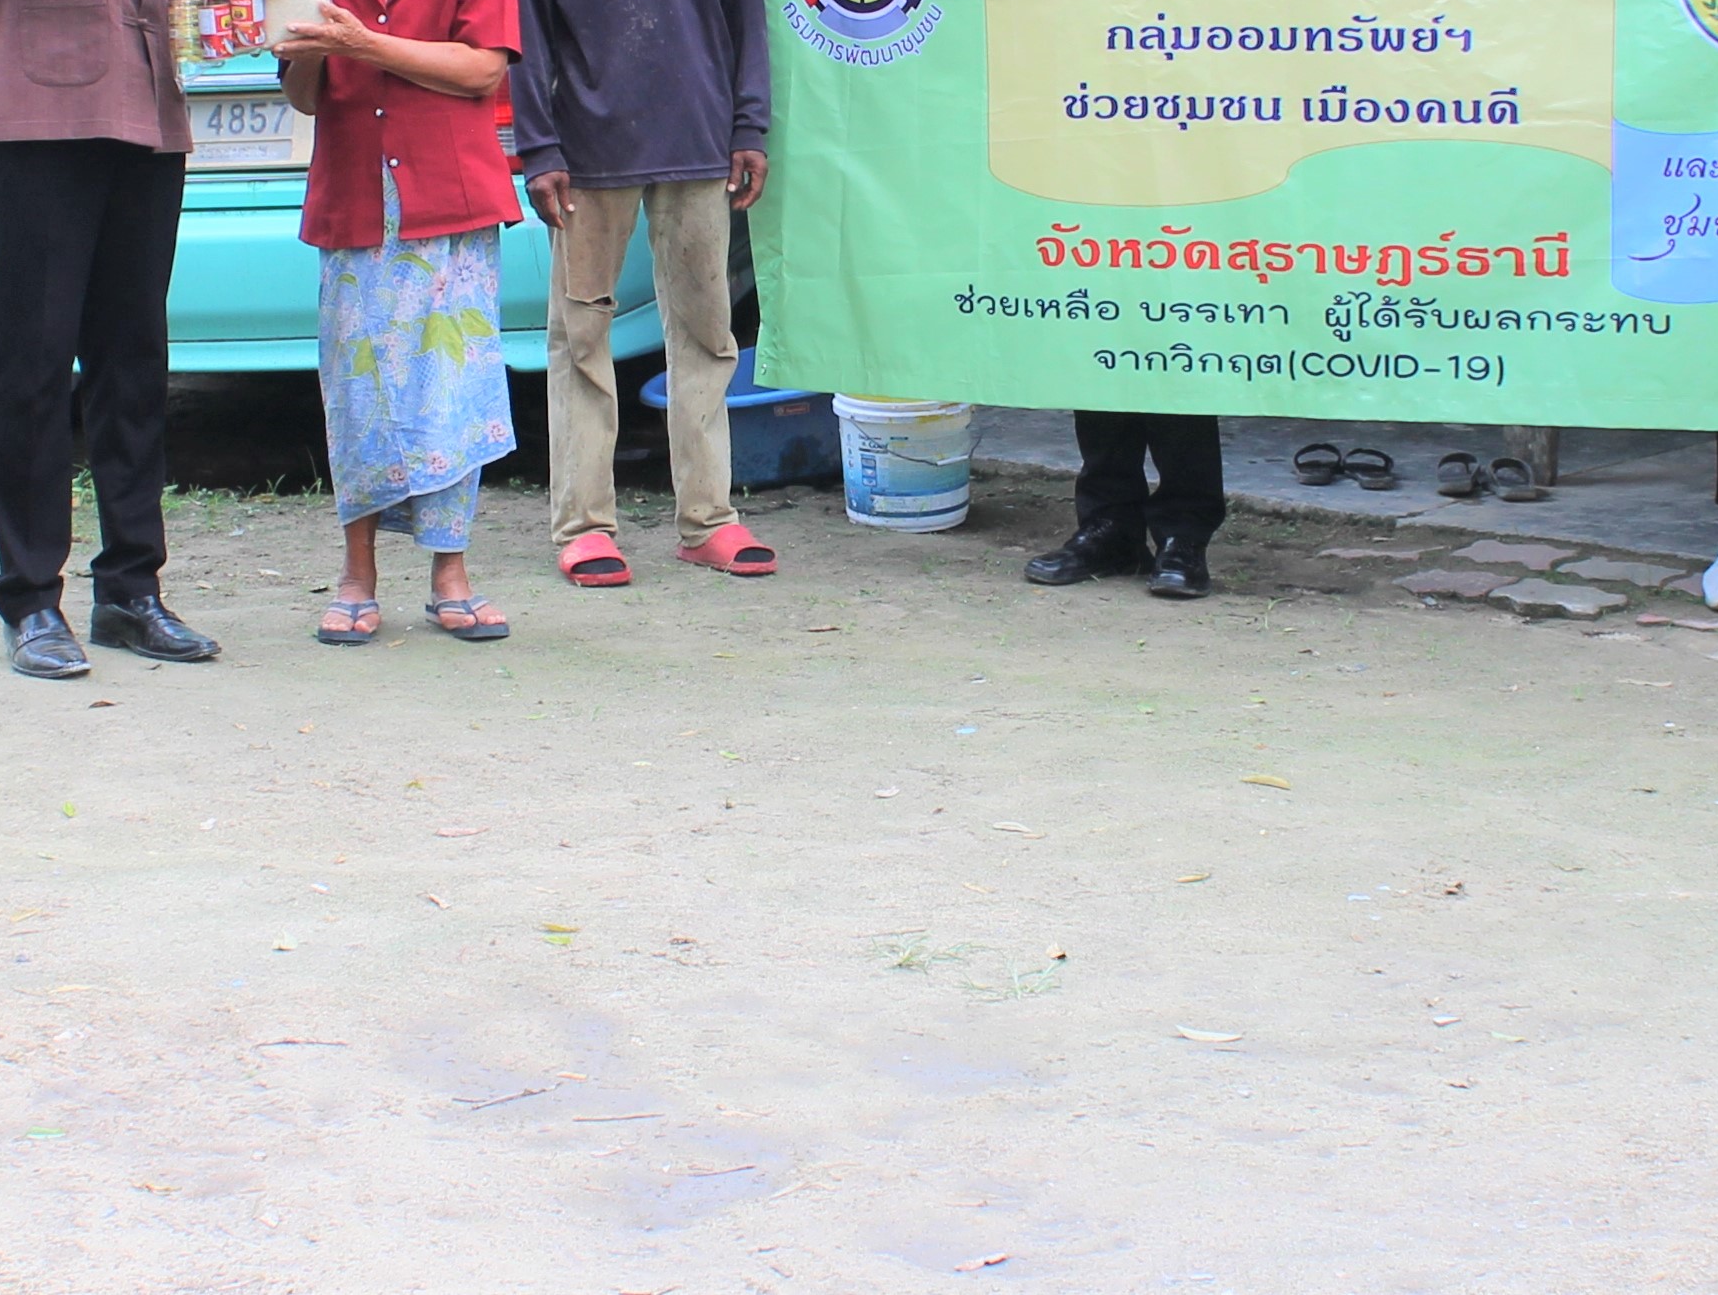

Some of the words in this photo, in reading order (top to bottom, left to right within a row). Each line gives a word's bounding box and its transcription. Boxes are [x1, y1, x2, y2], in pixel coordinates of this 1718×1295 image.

[782, 1, 943, 66] กรมการพัฒนาชุมชน
[1106, 12, 1473, 61] กลุ่มออมทรัพย์ฯ
[206, 102, 290, 135] 4857
[1062, 82, 1282, 131] ช่วยชุมชน
[1302, 84, 1520, 125] เมืองคนดี
[1035, 222, 1570, 286] จังหวัดสุราษฎร์ธานี
[954, 285, 1120, 322] ช่วยเหลือ
[1139, 301, 1290, 325] บรรเทา
[1324, 291, 1671, 343] ผู้ได้รับผลกระทบ
